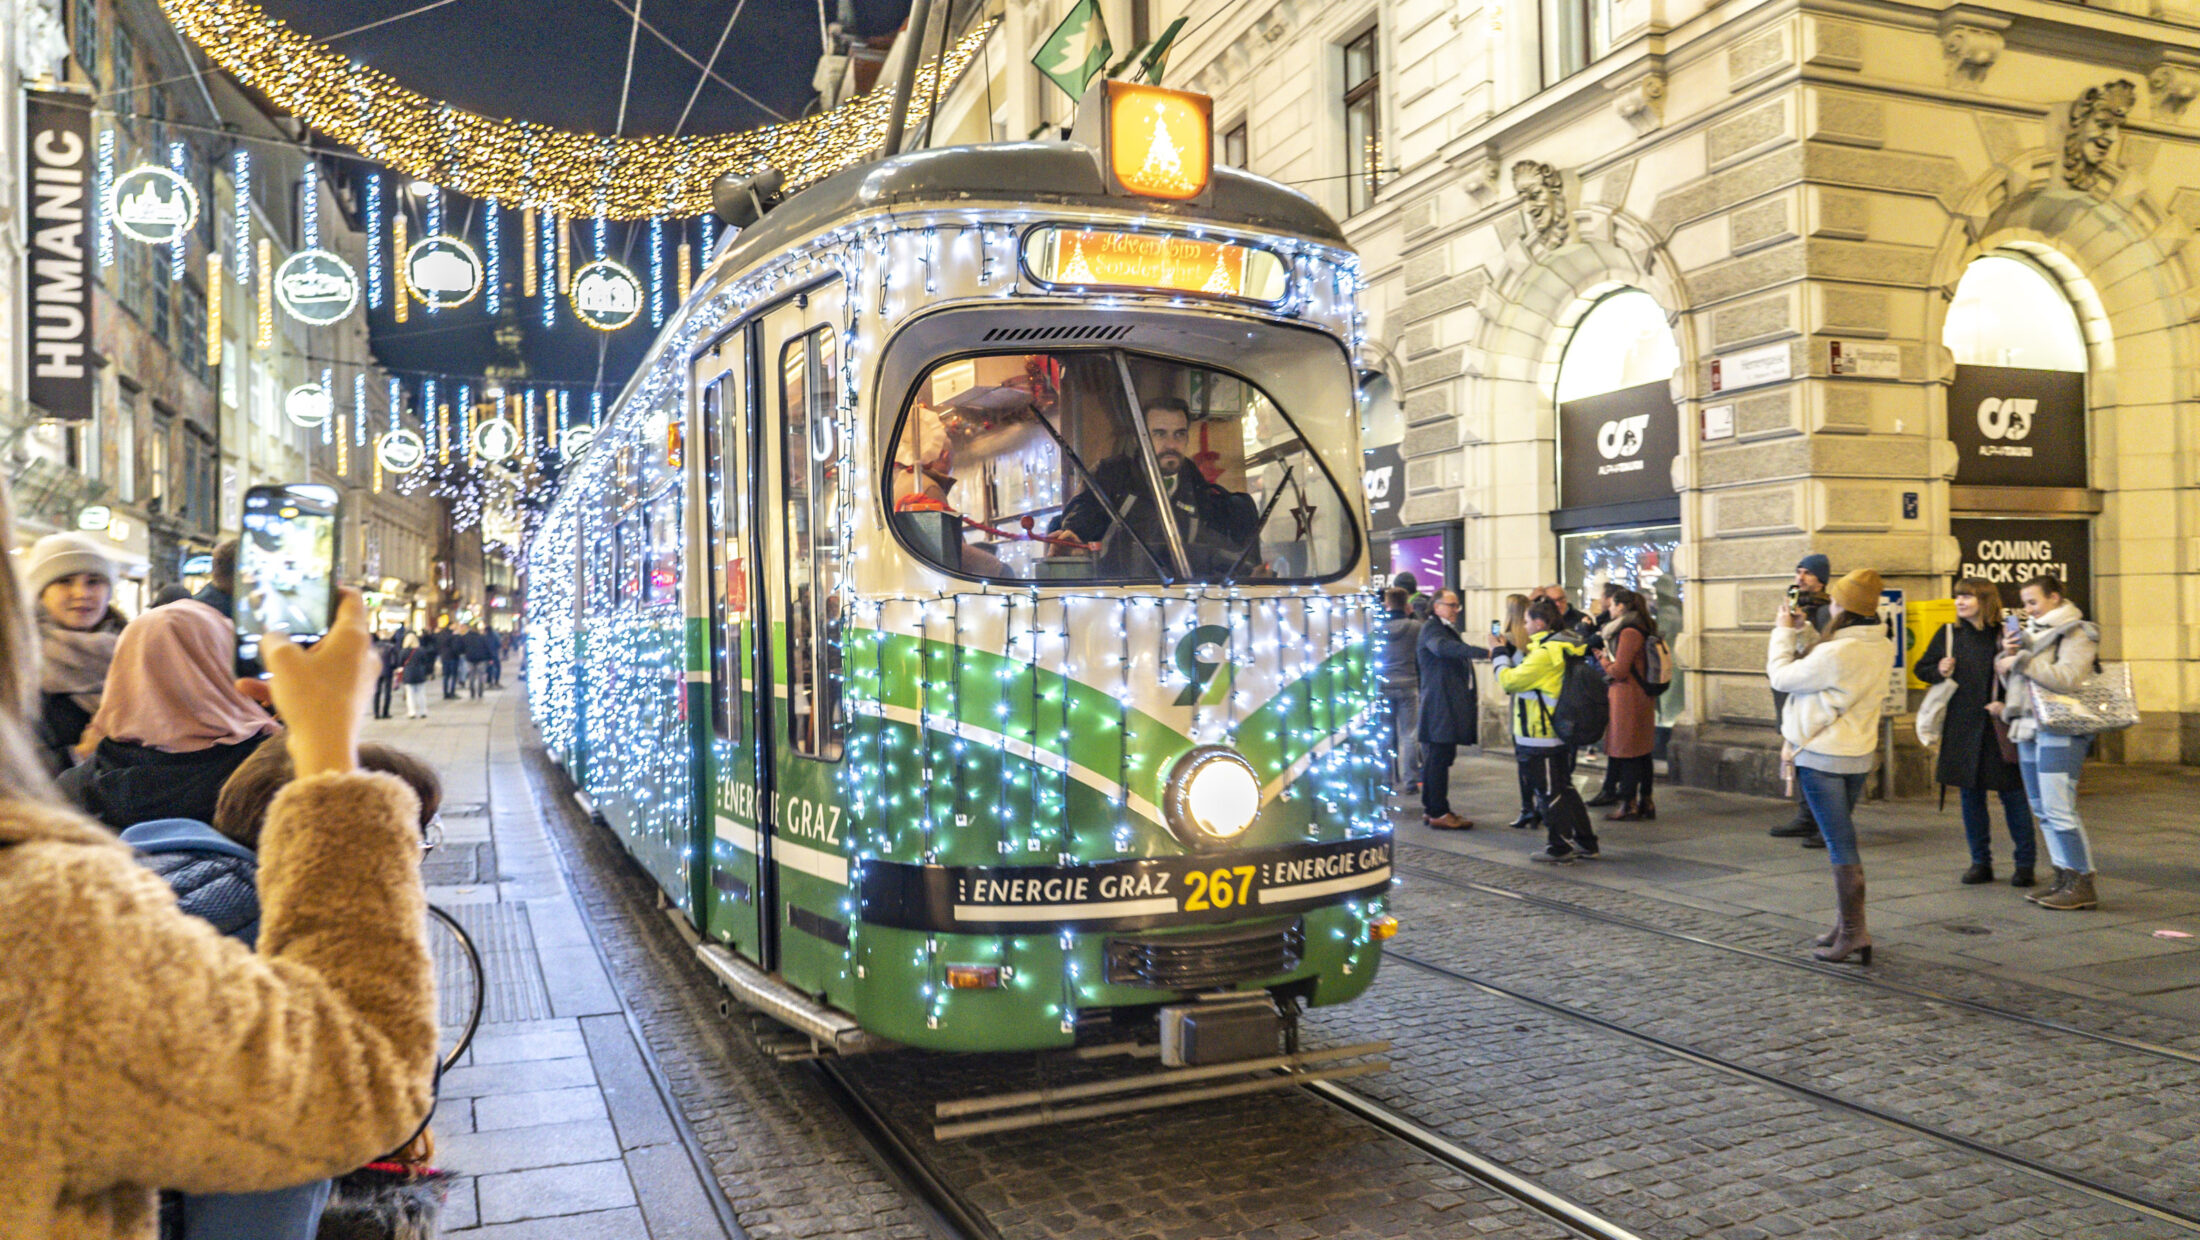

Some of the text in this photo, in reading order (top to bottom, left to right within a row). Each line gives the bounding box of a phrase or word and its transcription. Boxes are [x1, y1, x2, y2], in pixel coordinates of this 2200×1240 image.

[34, 130, 84, 379] HUMANIC
[1977, 540, 2052, 560] COMING
[1962, 563, 2014, 583] BACK
[724, 778, 841, 846] ENERGIE GRAZ
[1274, 843, 1390, 884] ENERGIE GRAZ
[973, 872, 1171, 902] ENERGIE GRAZ
[1184, 865, 1257, 912] 267
